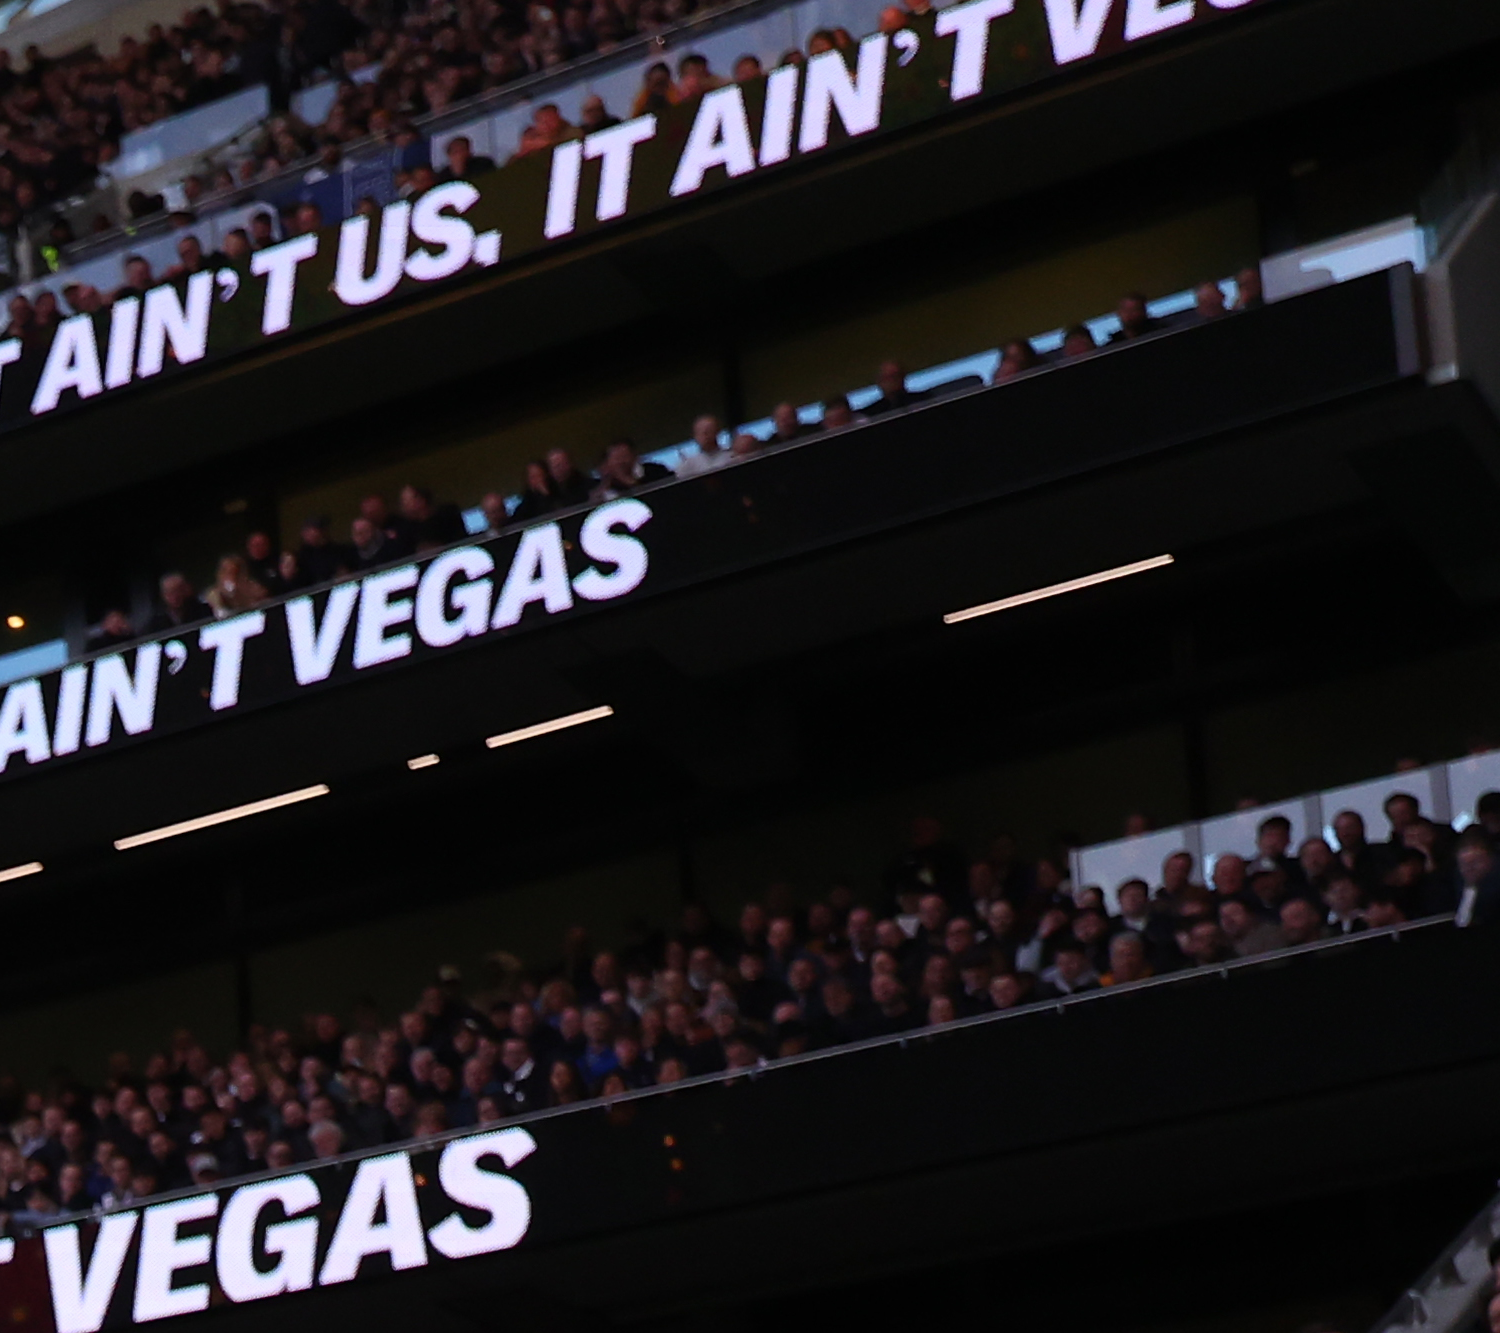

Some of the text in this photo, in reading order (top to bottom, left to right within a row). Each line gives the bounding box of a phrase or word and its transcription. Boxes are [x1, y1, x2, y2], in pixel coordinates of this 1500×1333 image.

[32, 235, 317, 414] AIN'T
[334, 183, 501, 305] US.
[545, 116, 657, 239] IT
[672, 0, 1013, 197] AIN'T
[286, 500, 651, 685] VEGAS
